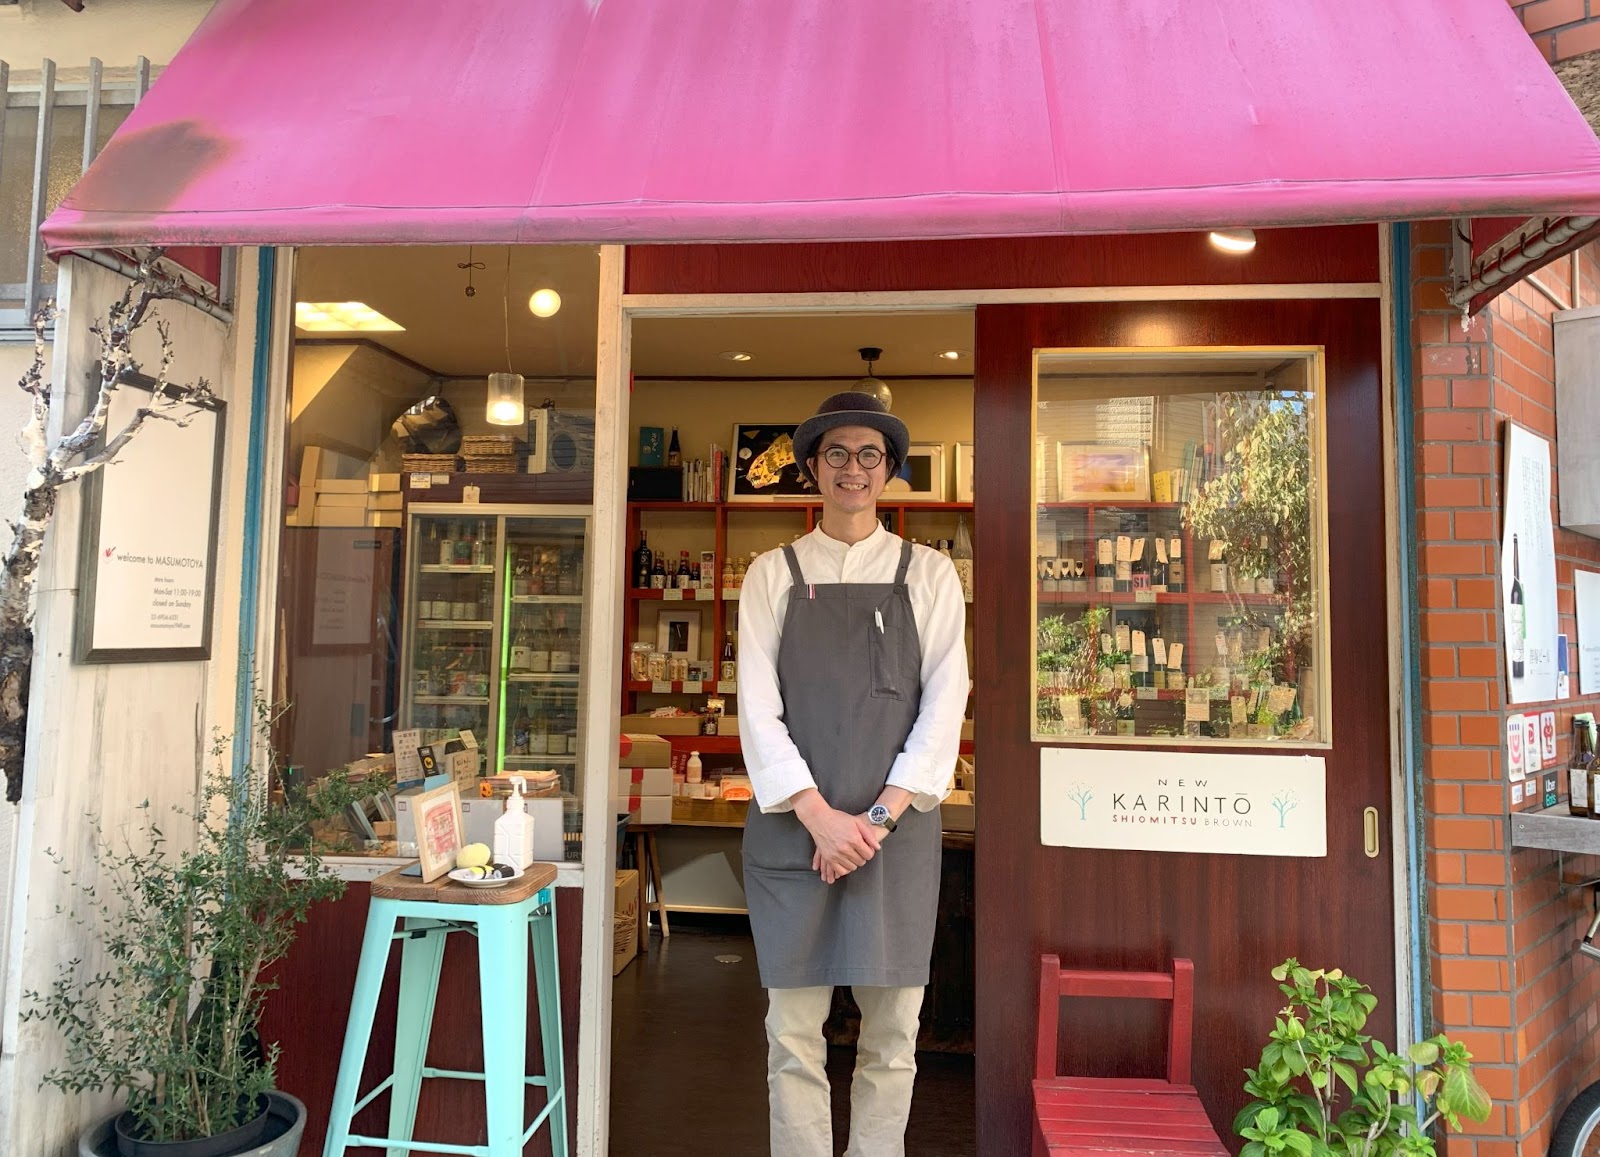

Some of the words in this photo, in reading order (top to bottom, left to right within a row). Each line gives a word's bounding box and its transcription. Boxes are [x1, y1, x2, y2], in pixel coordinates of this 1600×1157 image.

[117, 552, 145, 564] welcome
[147, 556, 153, 564] to
[155, 556, 204, 569] MASUMOTOYA
[152, 599, 168, 607] closed
[175, 599, 191, 610] Sunday
[1158, 778, 1208, 787] NEW
[1546, 779, 1556, 793] Uber
[1112, 792, 1252, 815] KARINTŌ
[1546, 793, 1557, 807] Eats
[1112, 815, 1198, 825] SHIOMITSU
[1204, 817, 1253, 828] BROWN
